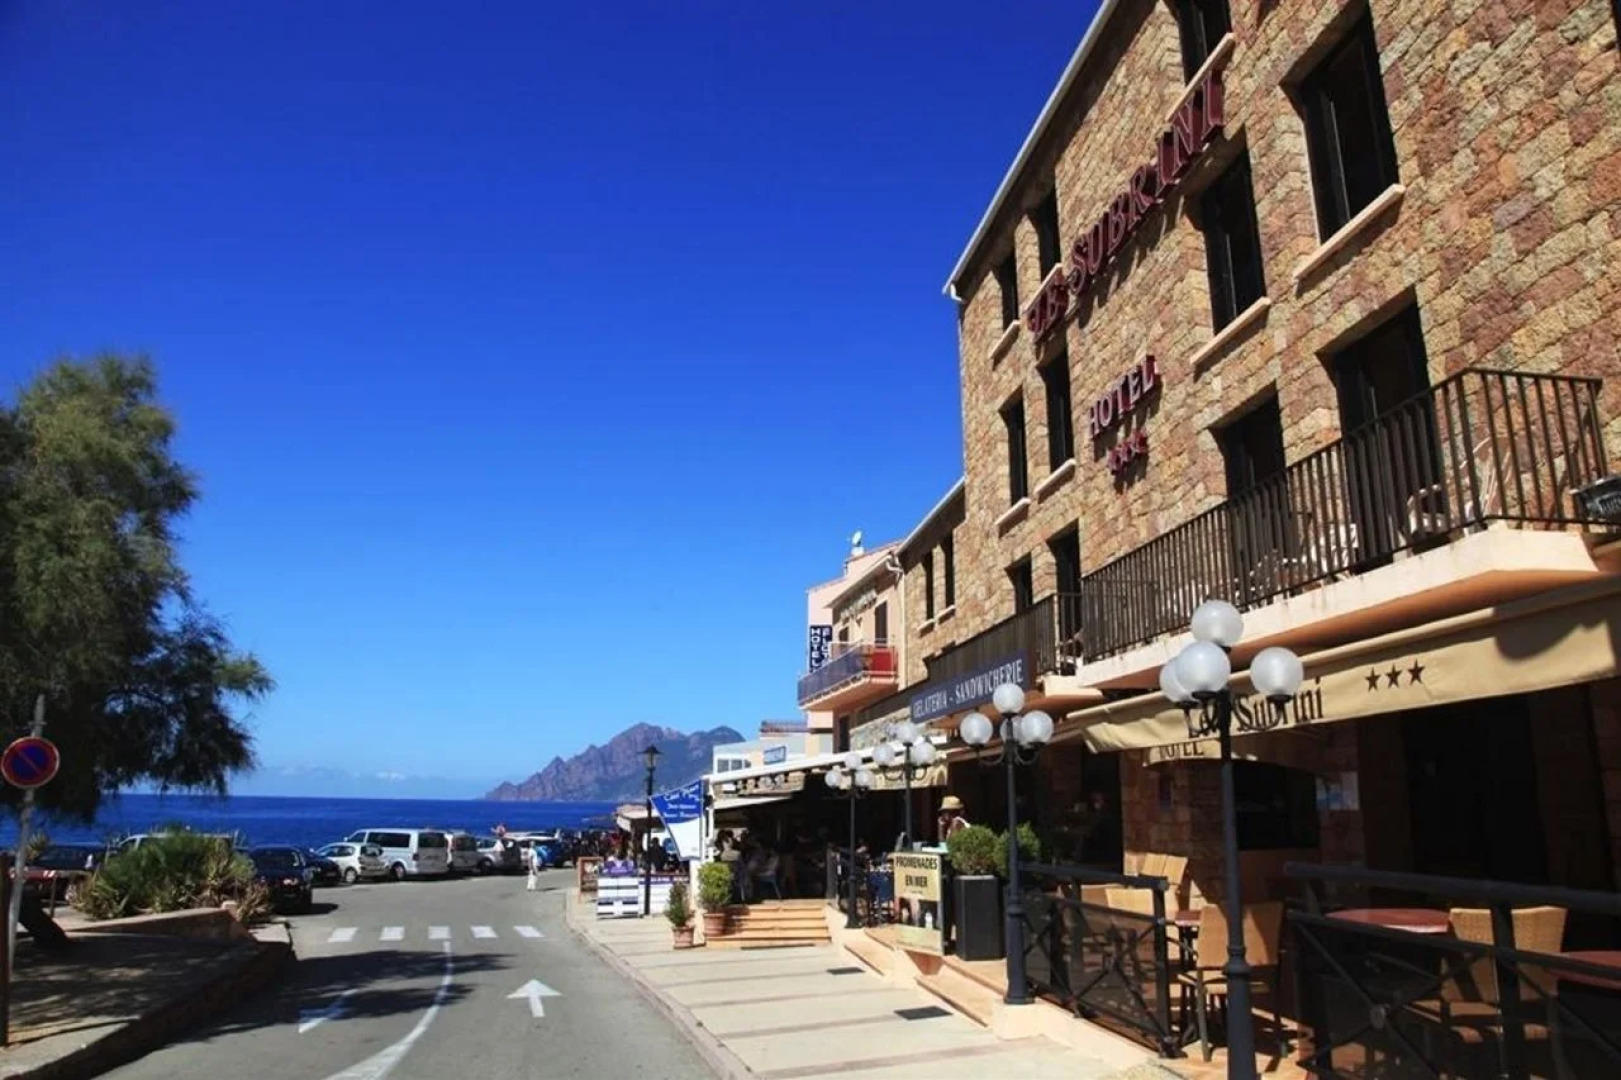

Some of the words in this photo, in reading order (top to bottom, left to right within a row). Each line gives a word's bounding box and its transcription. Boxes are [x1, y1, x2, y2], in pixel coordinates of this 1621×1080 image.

[1071, 69, 1225, 296] SUBRINI
[1089, 354, 1156, 438] HOTEL
[956, 659, 1024, 704] SANDWICHERIE
[896, 856, 938, 870] PROMENADES
